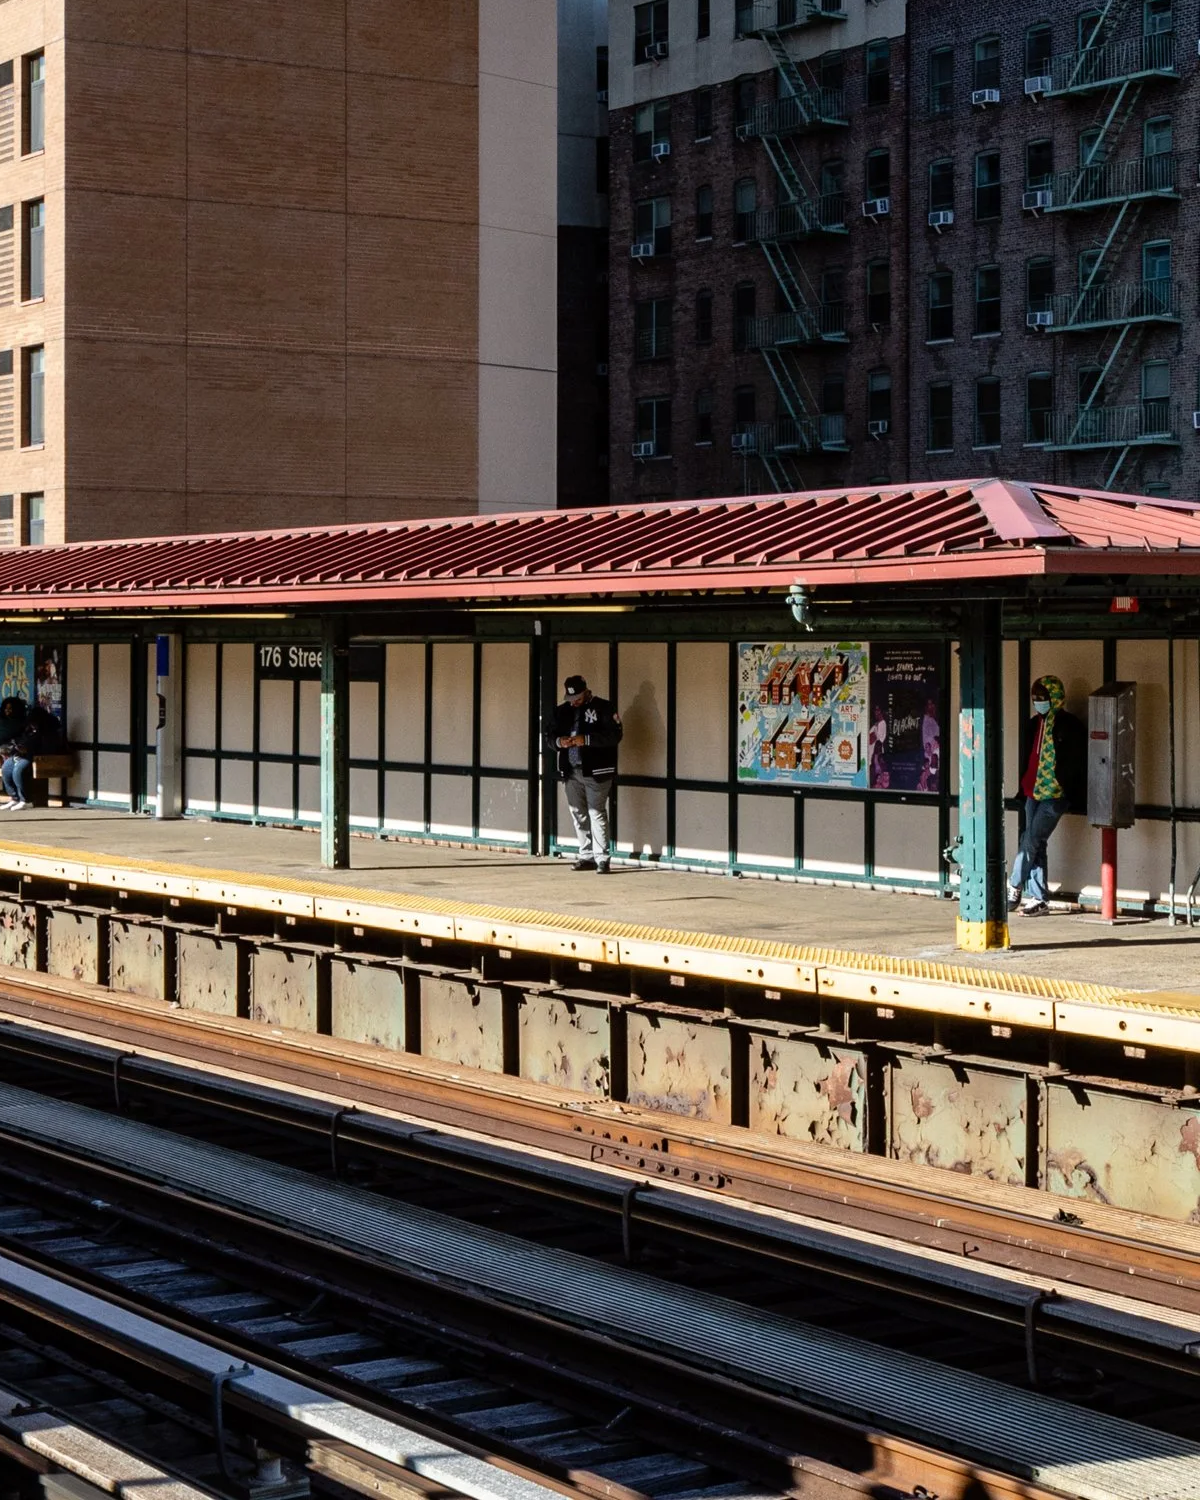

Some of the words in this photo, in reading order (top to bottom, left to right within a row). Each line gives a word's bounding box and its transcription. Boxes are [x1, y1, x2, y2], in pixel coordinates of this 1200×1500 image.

[260, 646, 281, 667] 176
[289, 646, 322, 668] Stree
[584, 708, 598, 724] NY
